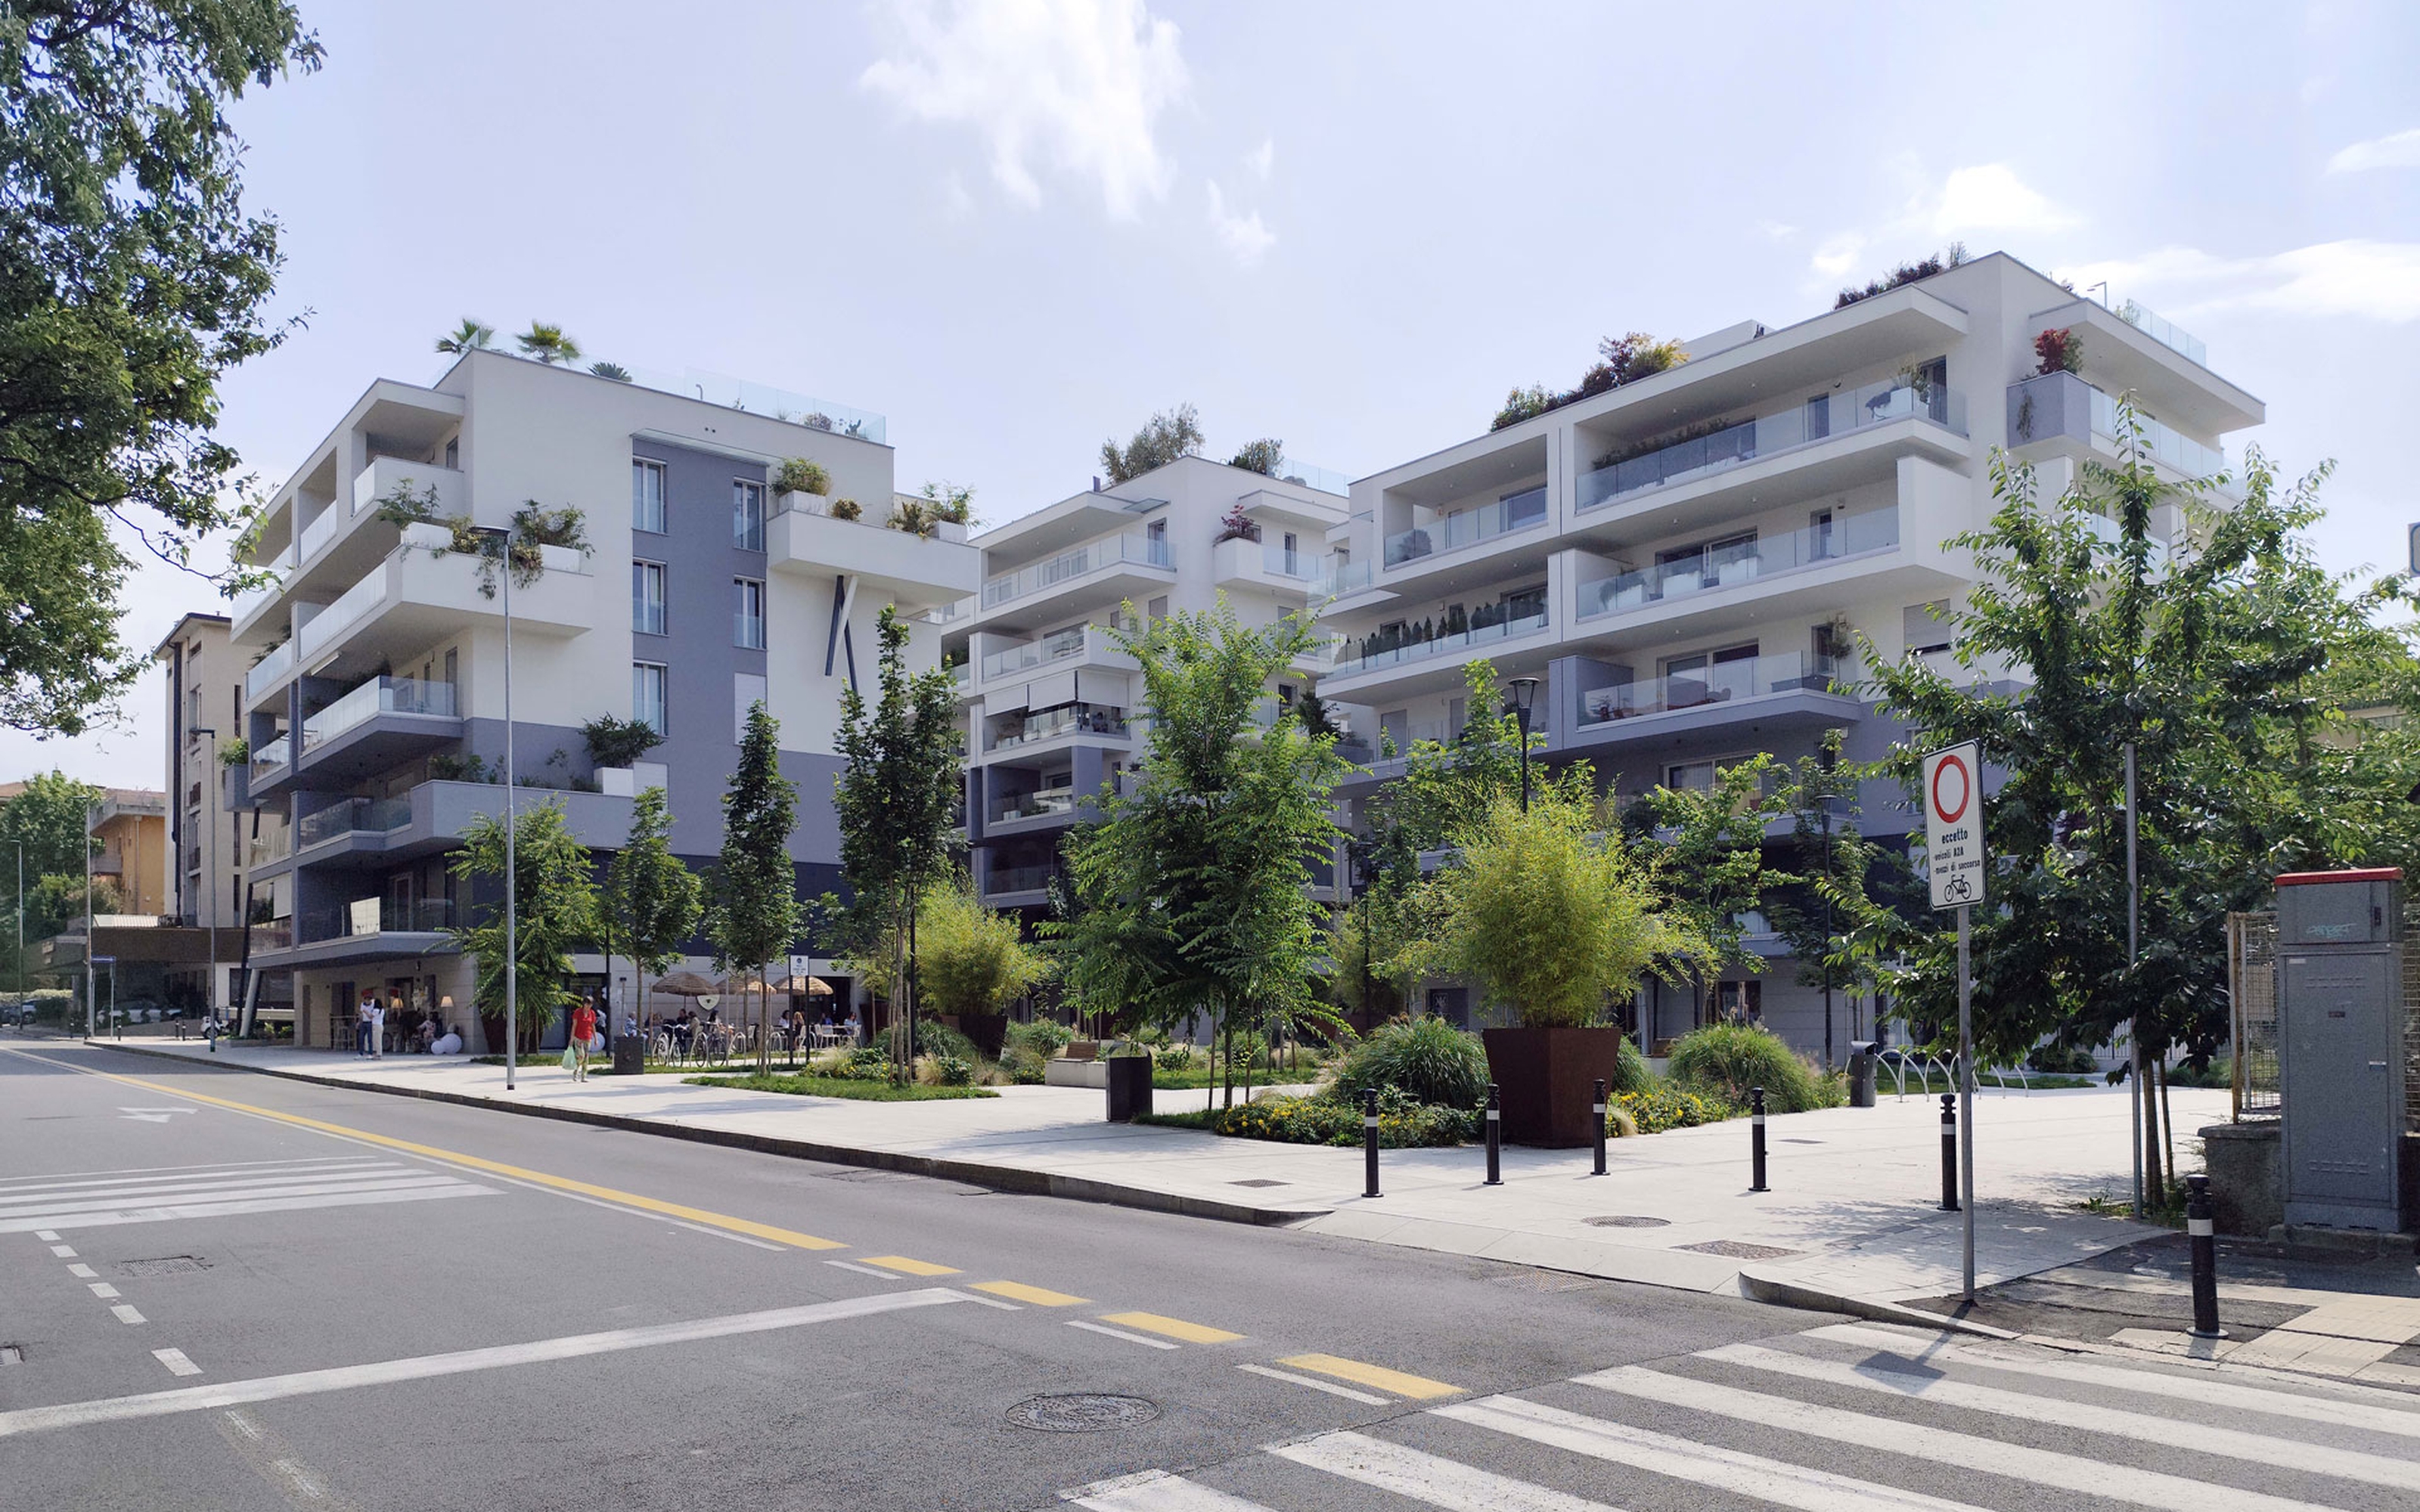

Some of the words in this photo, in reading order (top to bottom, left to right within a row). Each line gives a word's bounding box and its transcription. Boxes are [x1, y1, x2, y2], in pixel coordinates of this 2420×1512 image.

[1942, 828, 1968, 844] eccetto
[1953, 846, 1964, 857] A2A
[1950, 862, 1956, 872] di
[1958, 860, 1980, 870] soccorso
